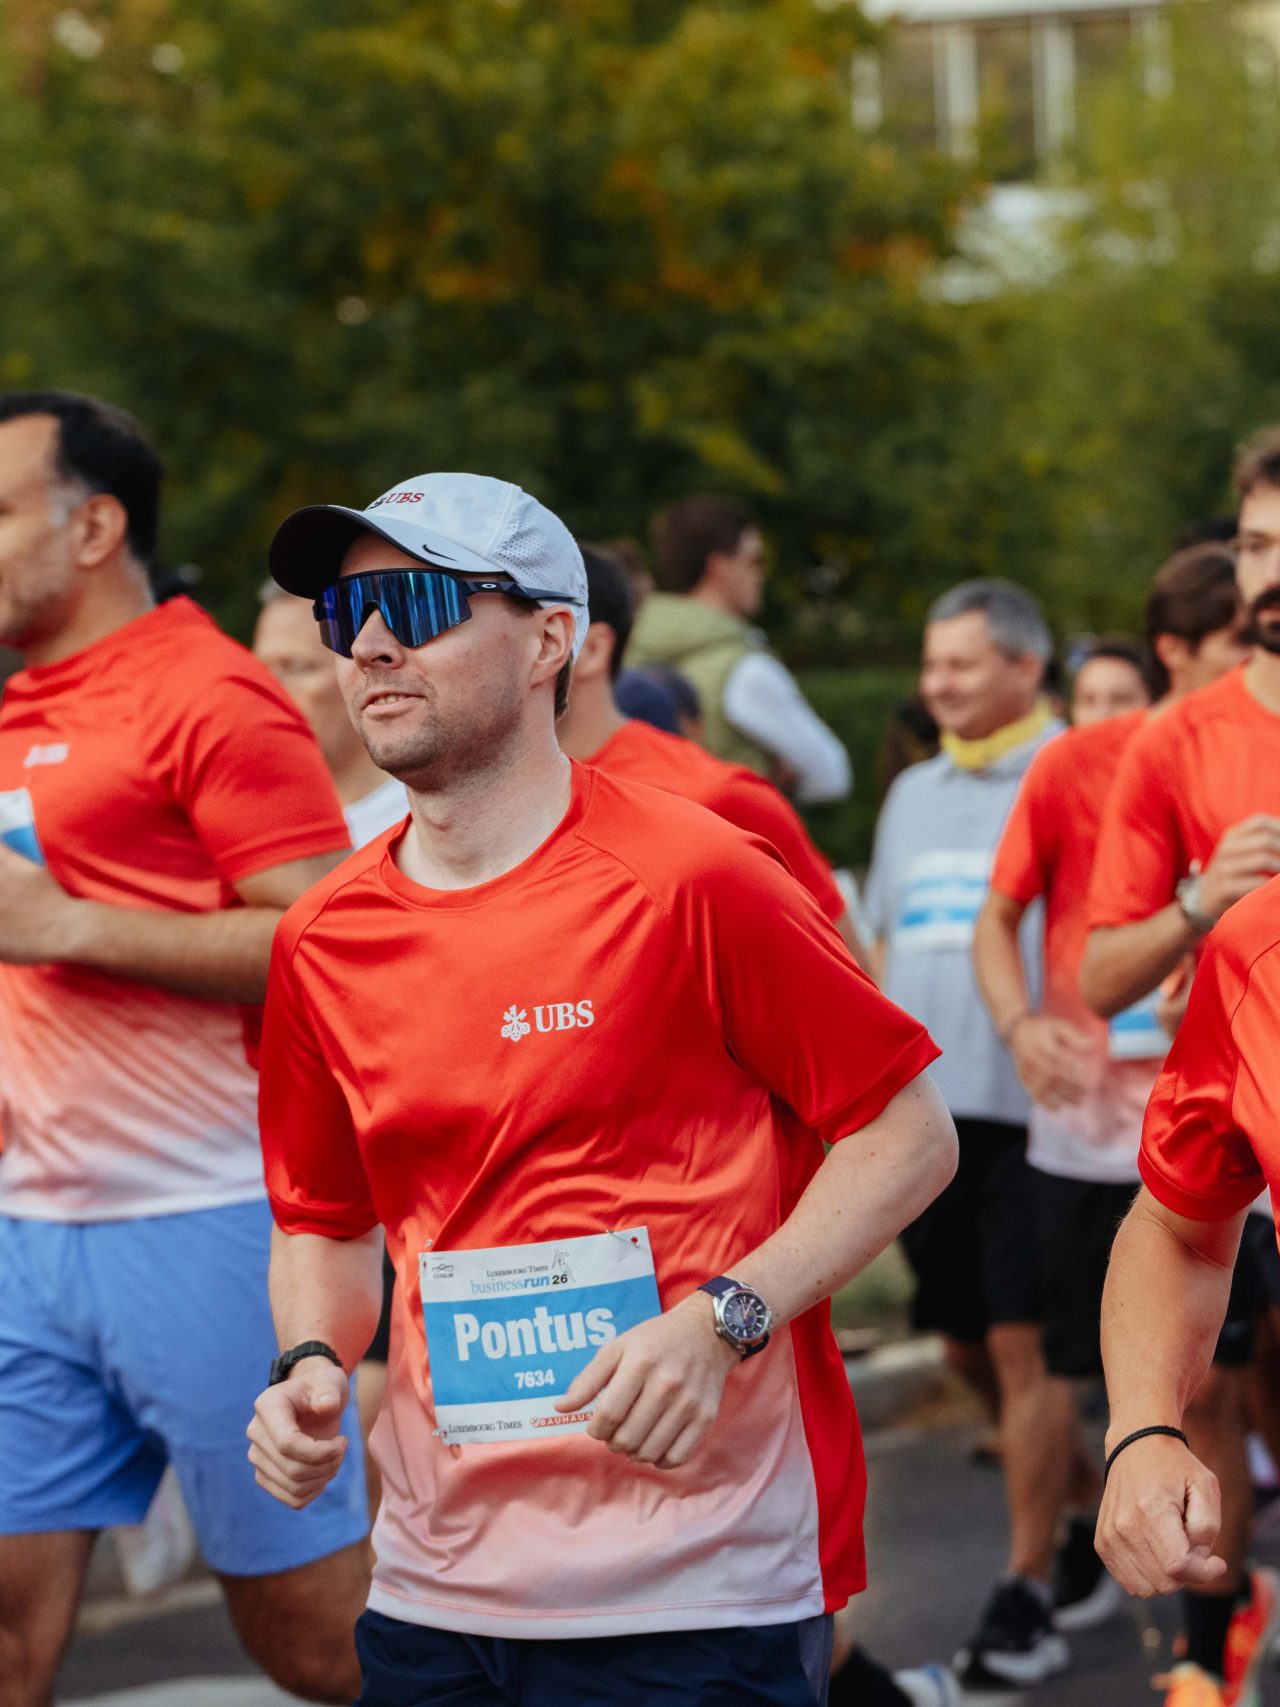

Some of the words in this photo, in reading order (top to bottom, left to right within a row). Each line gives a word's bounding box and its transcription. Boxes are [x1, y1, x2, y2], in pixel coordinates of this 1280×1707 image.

[385, 492, 425, 504] UBS
[533, 1000, 595, 1033] UBS
[552, 1274, 568, 1285] 26
[454, 1306, 617, 1361] Pontus
[515, 1369, 556, 1389] 7634
[448, 1422, 495, 1433] LUXEMBOURG
[496, 1420, 523, 1430] TIMES
